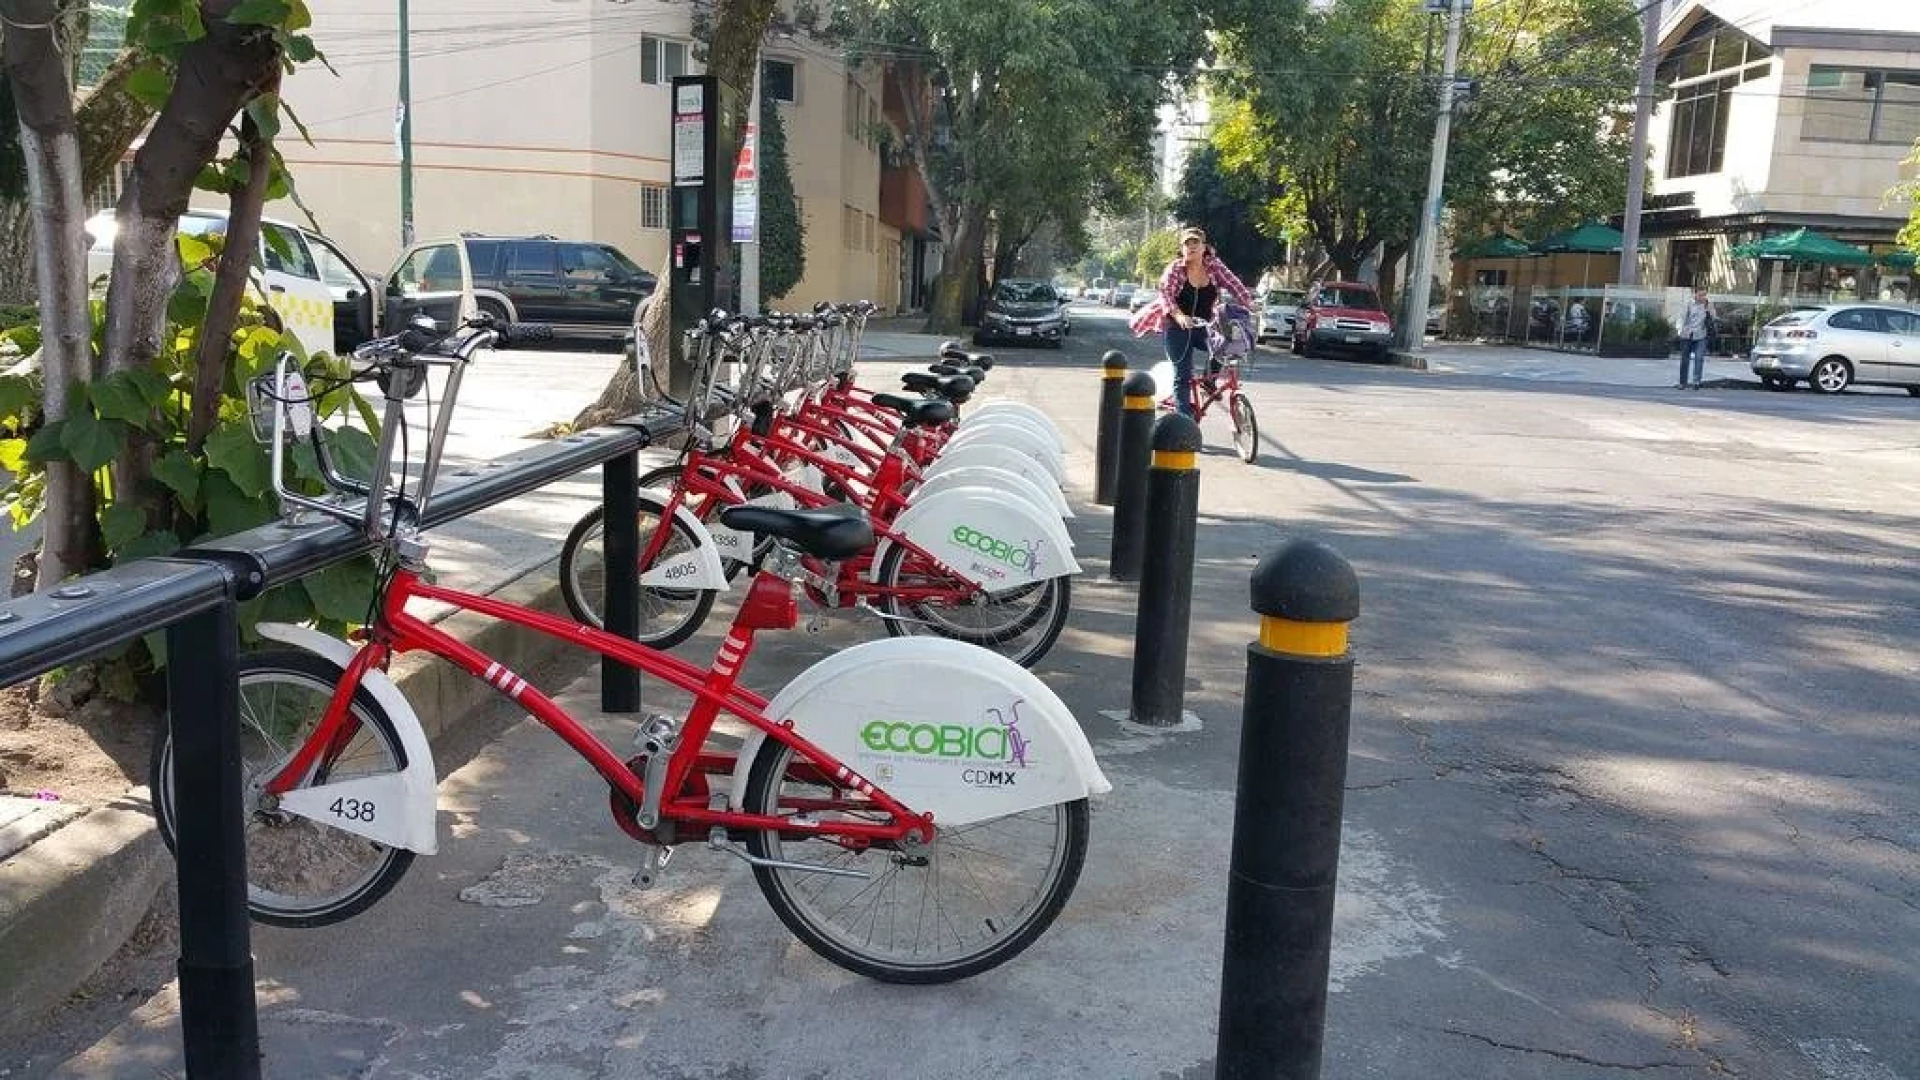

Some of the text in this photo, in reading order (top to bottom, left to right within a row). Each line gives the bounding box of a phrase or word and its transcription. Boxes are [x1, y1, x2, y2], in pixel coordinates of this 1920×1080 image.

[665, 562, 696, 579] 4805
[860, 720, 1007, 760] ECOBICI
[962, 768, 1016, 785] CDMX
[329, 796, 376, 822] 438
